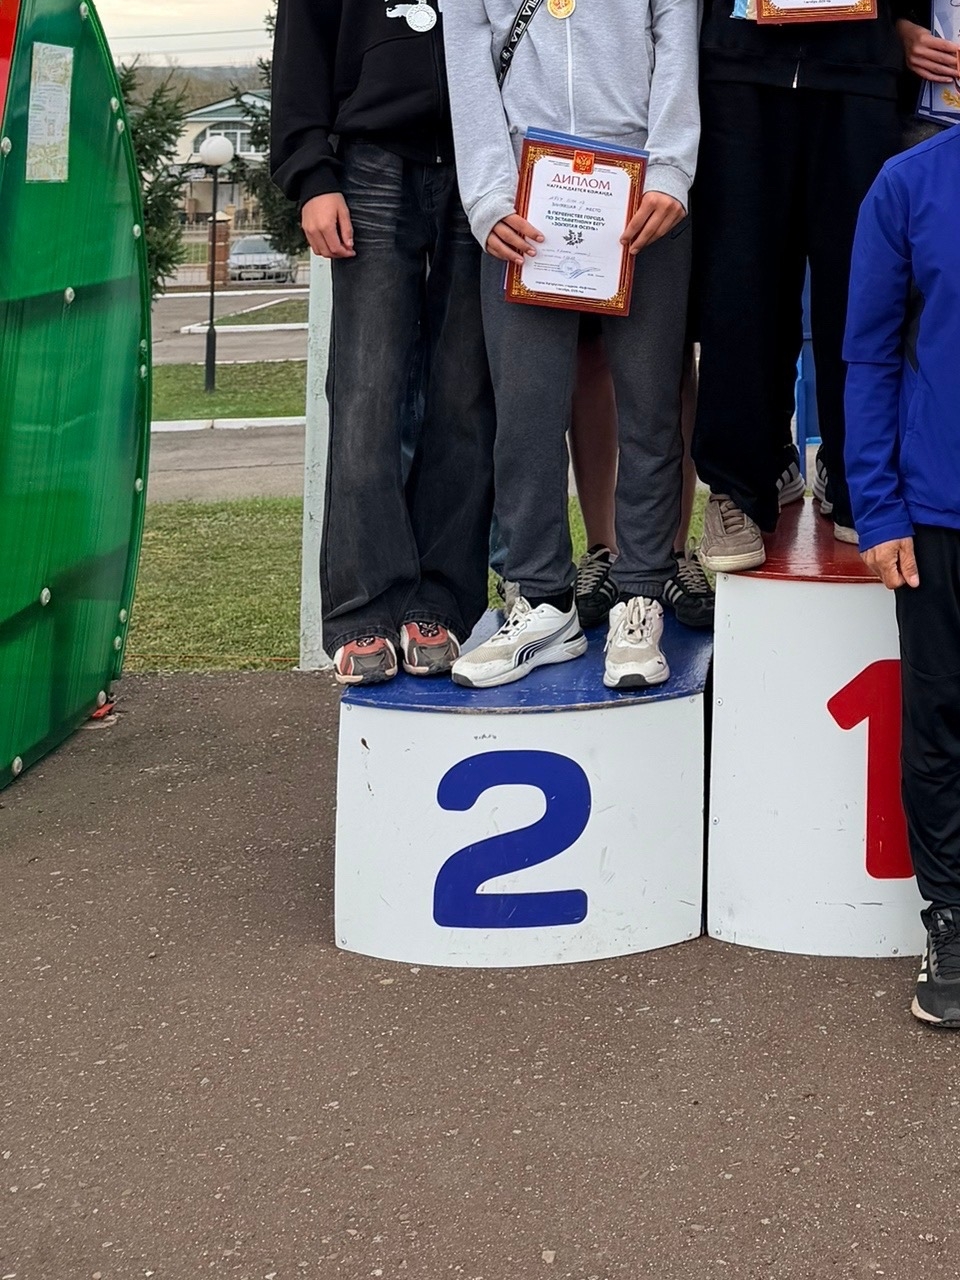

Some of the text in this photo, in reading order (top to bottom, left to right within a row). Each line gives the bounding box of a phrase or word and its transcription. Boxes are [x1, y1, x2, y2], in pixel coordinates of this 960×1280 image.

[510, 20, 526, 42] FILA
[546, 183, 613, 197] НАГРАЖДАЕТСЯ КОМАНДА
[552, 173, 611, 190] ДИПЛОМ
[551, 210, 584, 220] ПЕРВЕНСТВЕ
[584, 214, 605, 222] ГОРОДА
[827, 660, 913, 878] 1
[434, 750, 591, 928] 2
